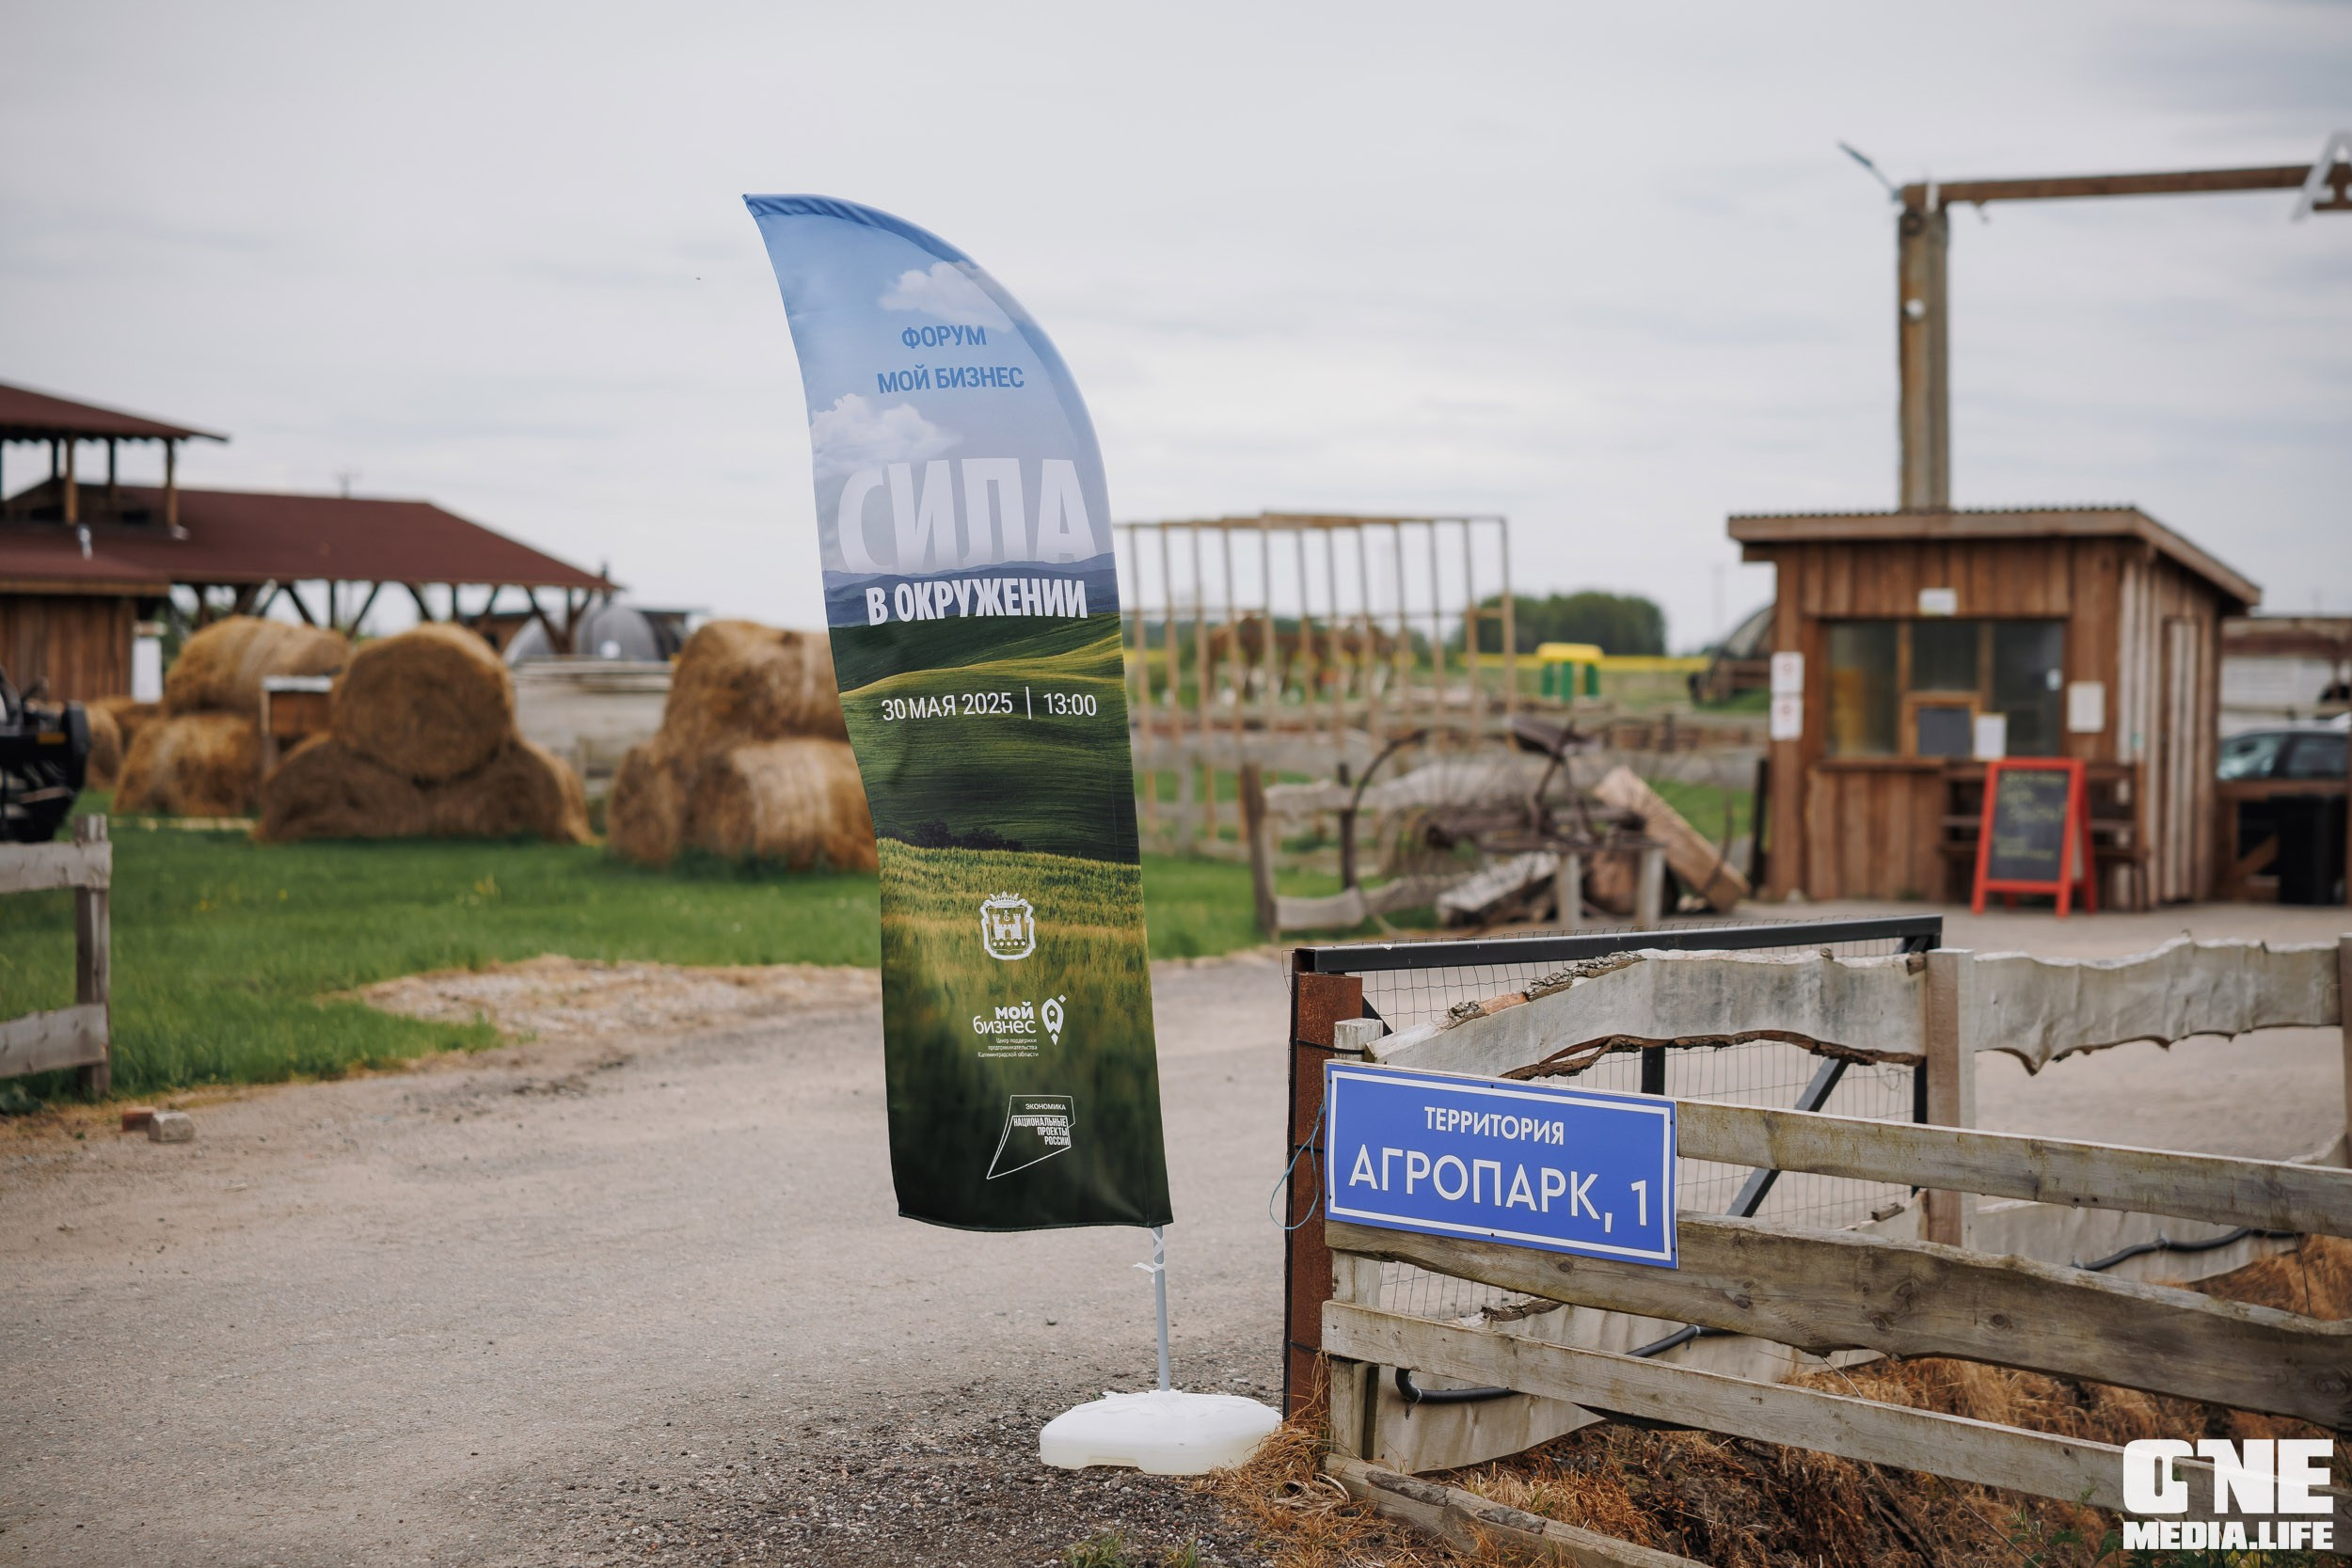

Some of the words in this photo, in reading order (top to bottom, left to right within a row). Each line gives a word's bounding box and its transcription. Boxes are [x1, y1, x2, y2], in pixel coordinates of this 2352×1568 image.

[901, 325, 987, 349] ФОРУМ
[877, 364, 930, 393] МОЙ
[935, 366, 1025, 389] БИЗНЕС
[837, 458, 1098, 572] СИЛА
[866, 586, 889, 626] В
[895, 578, 1088, 622] ОКРУЖЕНИИ
[881, 698, 906, 721] 30
[909, 694, 956, 719] МАЯ
[961, 692, 1013, 716] 2025
[1043, 692, 1097, 717] 13:00
[994, 1001, 1034, 1020] мой
[973, 1015, 1037, 1035] бизнес
[1013, 1117, 1067, 1127] НАЦИОНАЛЬНЫЕ
[1037, 1127, 1068, 1137] ПРОЕКТЫ
[1423, 1105, 1565, 1146] ТЕРРИТОРИЯ
[1044, 1136, 1071, 1146] РОССИИ
[1348, 1144, 1613, 1233] АГРОПАРК,
[1630, 1180, 1647, 1227] 1
